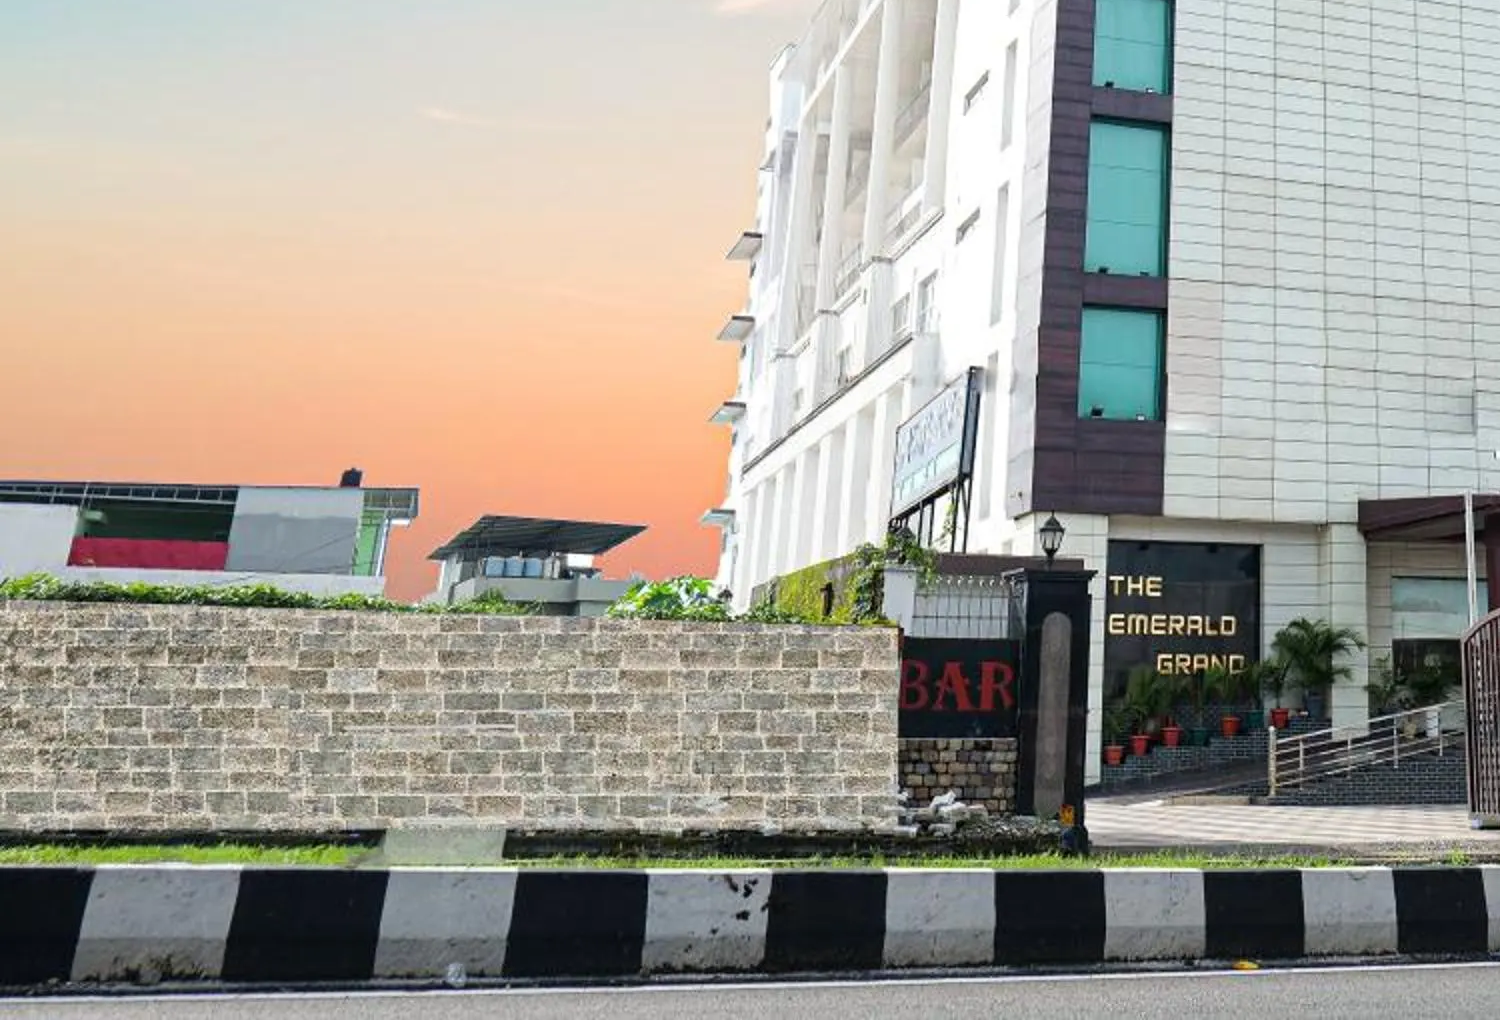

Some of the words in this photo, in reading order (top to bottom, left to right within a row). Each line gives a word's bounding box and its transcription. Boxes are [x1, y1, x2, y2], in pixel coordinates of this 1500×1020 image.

[1108, 575, 1163, 597] THE
[1108, 613, 1237, 636] EMERALD
[1157, 653, 1245, 675] GRAND
[899, 659, 1016, 712] BAR
